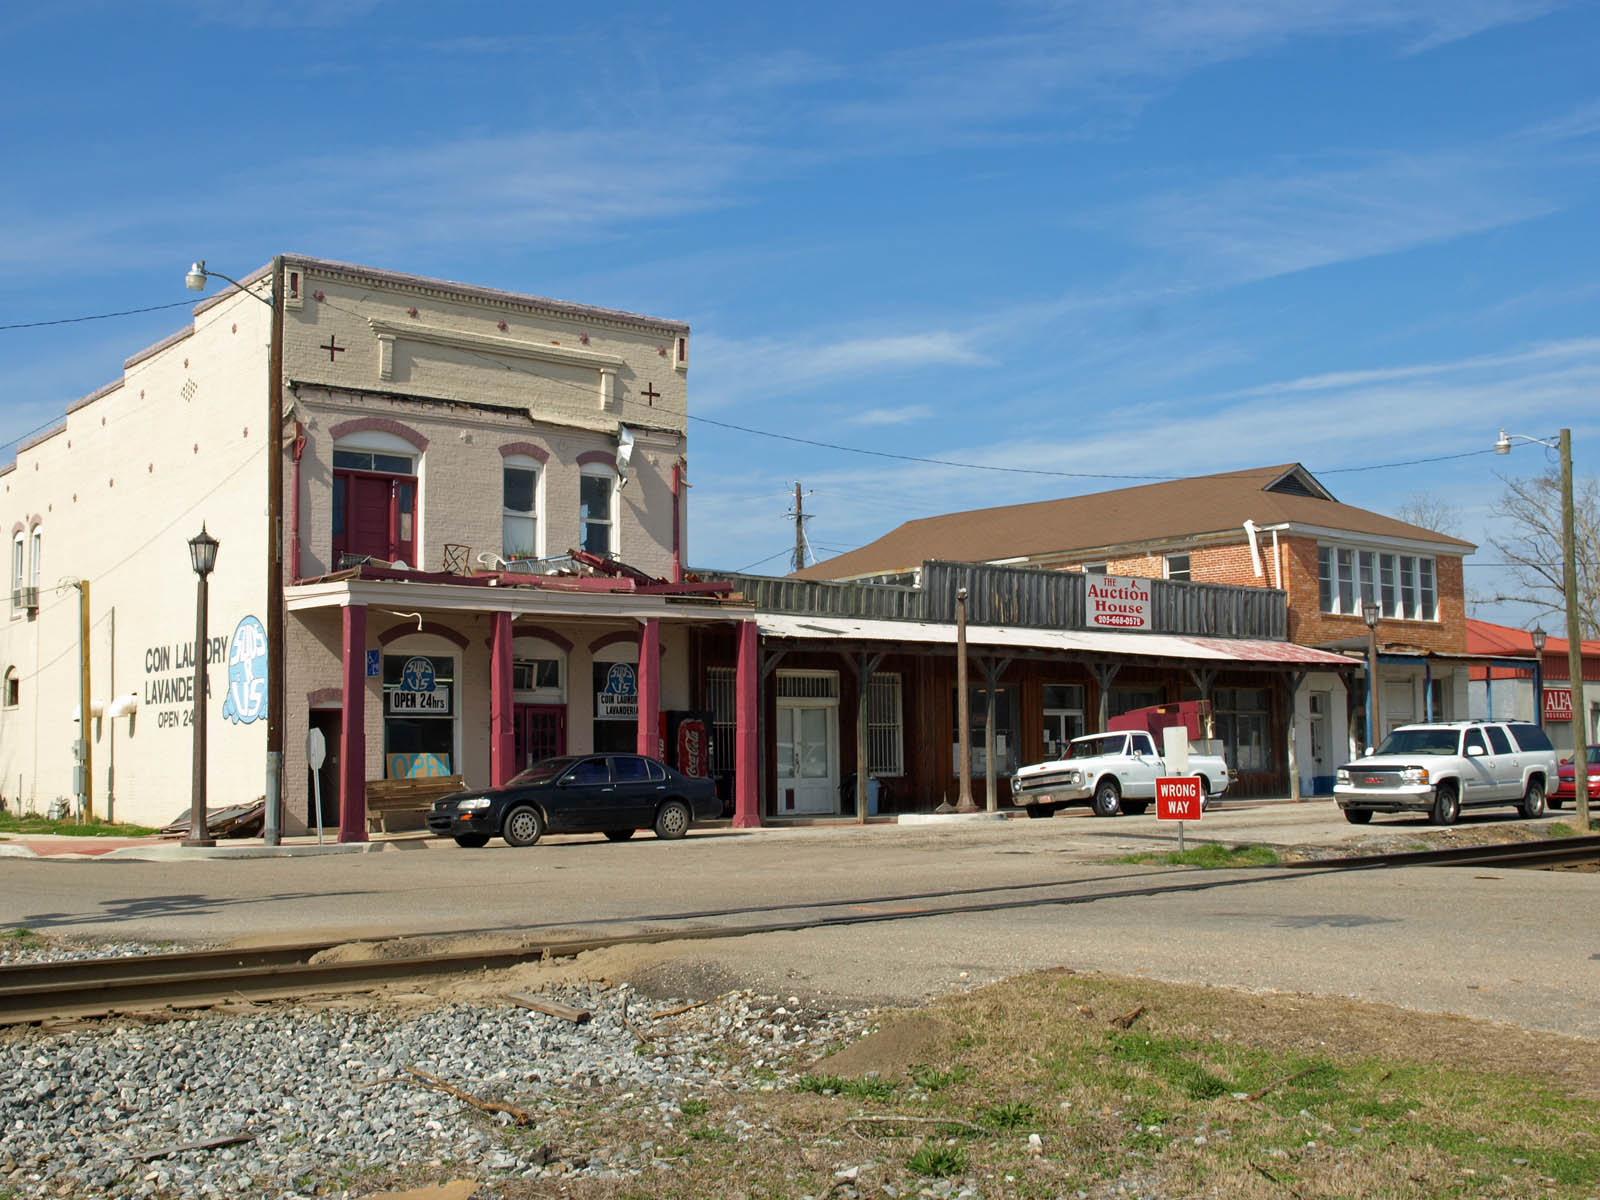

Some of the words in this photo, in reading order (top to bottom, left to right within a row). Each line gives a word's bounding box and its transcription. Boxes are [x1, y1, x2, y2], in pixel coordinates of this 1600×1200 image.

[1104, 578, 1116, 586] THE
[1088, 583, 1148, 601] Auction
[1095, 600, 1143, 614] House
[145, 645, 170, 674] COIN
[175, 636, 229, 669] LAUDRY
[145, 673, 212, 705] LAVANDEA
[407, 678, 430, 690] US
[231, 678, 265, 717] US
[394, 692, 417, 708] OPEN
[601, 695, 615, 705] COIN
[616, 695, 638, 705] LAUND
[1546, 691, 1573, 711] ALFA
[158, 711, 179, 729] OPEN
[391, 753, 451, 779] OPEN
[1160, 784, 1196, 797] WRONG
[1168, 801, 1190, 814] WAY
